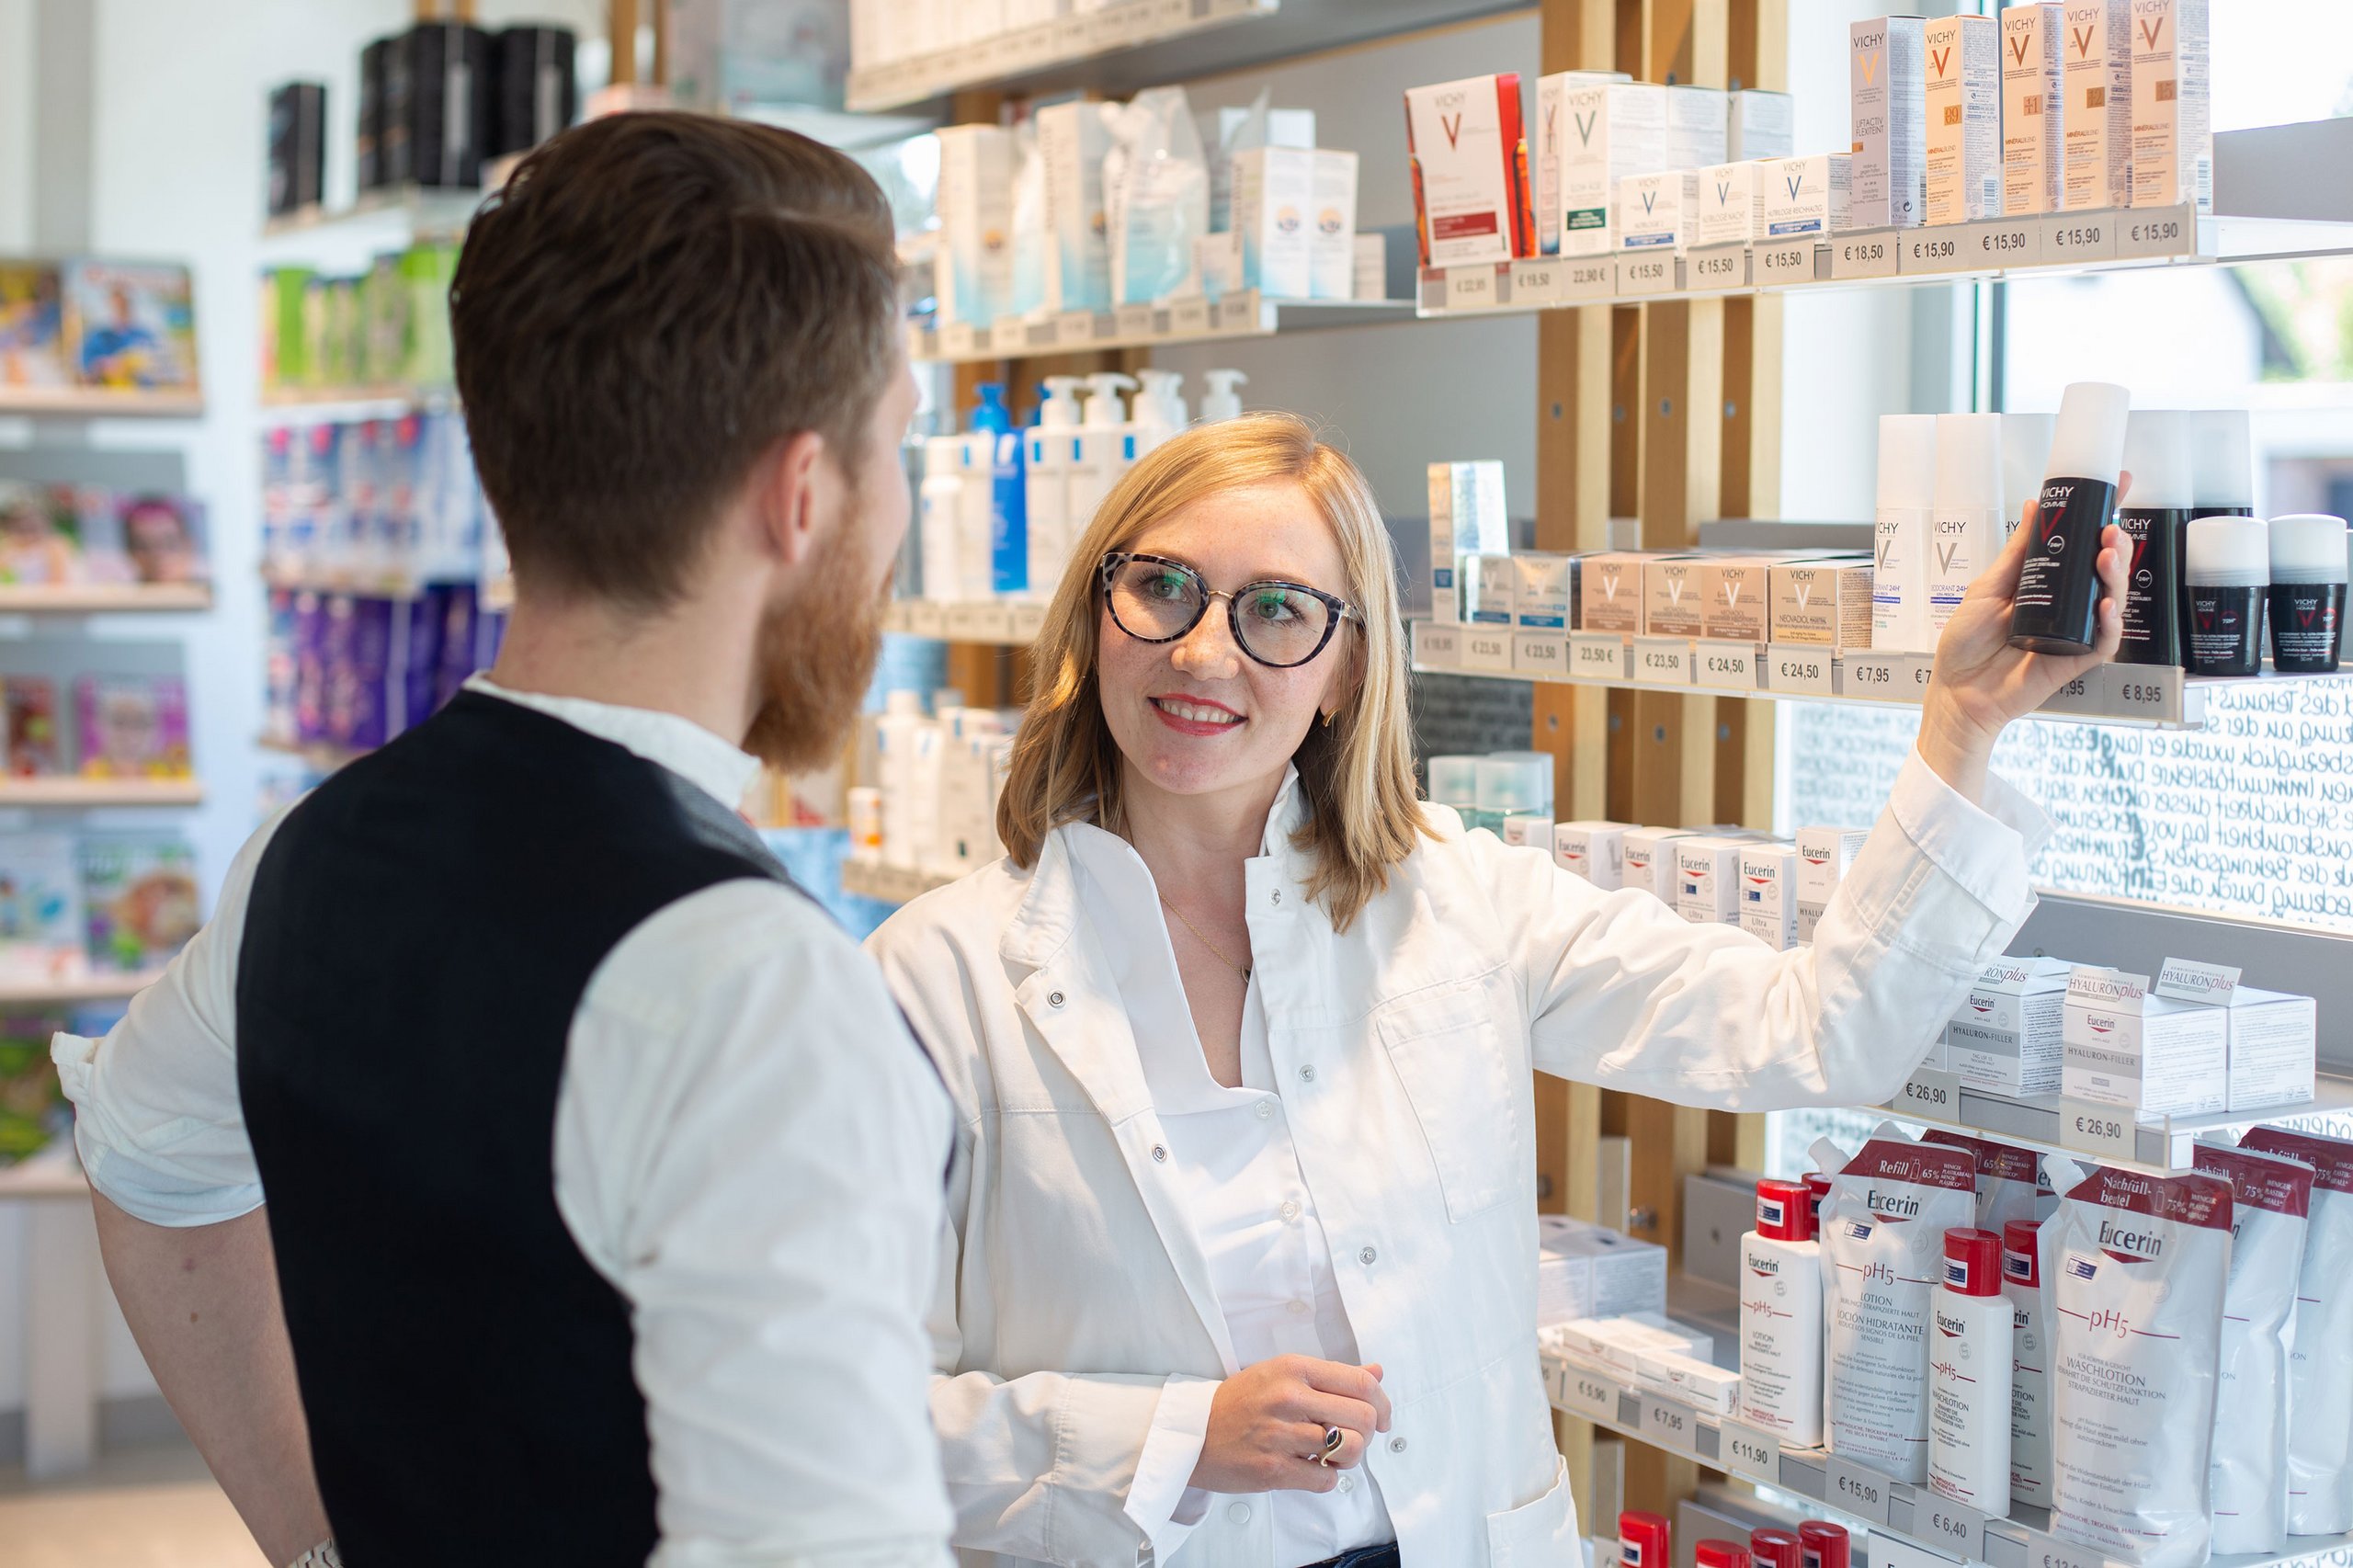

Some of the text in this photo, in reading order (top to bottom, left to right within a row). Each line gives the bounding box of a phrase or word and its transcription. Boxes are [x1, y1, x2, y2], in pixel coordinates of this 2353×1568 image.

[2067, 8, 2100, 22] VICHY
[2134, 0, 2170, 14] VICHY
[2005, 17, 2036, 31] VICHY
[1854, 32, 1884, 48] VICHY
[1927, 29, 1956, 44] VICHY
[2073, 25, 2094, 59] V
[2140, 17, 2163, 51] V
[2010, 34, 2029, 66] V
[1858, 51, 1879, 86] V
[1931, 47, 1950, 79] V
[1568, 90, 1602, 107] VICHY
[1856, 117, 1883, 129] LIFTACTIV
[1715, 168, 1734, 178] VICHY
[1783, 161, 1807, 173] VICHY
[2056, 228, 2100, 246] € 15,90
[2131, 222, 2177, 242] € 15,90
[1914, 242, 1955, 259] € 15,90
[1983, 233, 2026, 252] € 15,90
[1766, 252, 1802, 269] € 15,50
[1845, 244, 1883, 262] € 18,50
[1630, 263, 1664, 279] € 15,50
[1699, 258, 1733, 276] € 15,50
[2041, 486, 2074, 498] VICHY
[1933, 521, 1966, 534] VICHY
[2040, 508, 2066, 544] V
[2120, 518, 2152, 530] VICHY
[1936, 542, 1958, 576] V
[1599, 563, 1622, 574] VICHY
[1665, 566, 1688, 576] VICHY
[1721, 569, 1745, 579] VICHY
[1790, 570, 1815, 580] VICHY
[1779, 615, 1809, 624] NEOVADOL
[1525, 645, 1556, 659] € 23,50
[1581, 647, 1613, 663] 23,50 €
[1646, 653, 1678, 669] € 23,50
[1708, 658, 1744, 674] € 24,50
[1781, 663, 1819, 680] € 24,50
[1857, 667, 1889, 684] € 7,95
[2122, 685, 2161, 704] € 8,95
[1558, 838, 1586, 854] Eucerin
[1625, 846, 1651, 862] Eucerin
[1802, 846, 1831, 859] Eucerin
[1680, 855, 1711, 871] Eucerin
[1744, 861, 1776, 879] Eucerin
[1688, 910, 1703, 920] Ultra
[1751, 917, 1767, 927] Ultra
[1970, 994, 1995, 1008] Eucerin
[2087, 1014, 2115, 1028] Eucerin
[1953, 1026, 2013, 1044] HYALURON-FILLER
[2068, 1047, 2135, 1066] HYALURON-FILLER
[1905, 1082, 1947, 1104] € 26,90
[2075, 1117, 2121, 1139] € 26,90
[1879, 1160, 1909, 1176] Refill
[1922, 1168, 1939, 1180] 65%
[2103, 1176, 2152, 1195] Nachfüll-
[2100, 1191, 2130, 1208] beutel
[2167, 1199, 2187, 1213] 75%
[2098, 1221, 2162, 1256] Eucerin
[1748, 1254, 1779, 1273] Eucerin
[1862, 1262, 1893, 1286] pH5
[1860, 1292, 1893, 1306] LOTION
[1753, 1301, 1772, 1317] pH5
[1866, 1317, 1925, 1335] HIDRATANTE
[1937, 1311, 1965, 1334] Eucerin
[2088, 1310, 2129, 1338] pH5
[1939, 1362, 1956, 1381] pH5
[2066, 1356, 2146, 1387] WASCHLOTION
[2093, 1378, 2166, 1399] SCHUTZFUNKTION
[2117, 1395, 2140, 1406] HAUT
[1654, 1409, 1683, 1430] € 7,95
[1733, 1440, 1768, 1464] € 11,90
[1838, 1476, 1878, 1504] € 15,90
[1932, 1513, 1967, 1539] € 6,40
